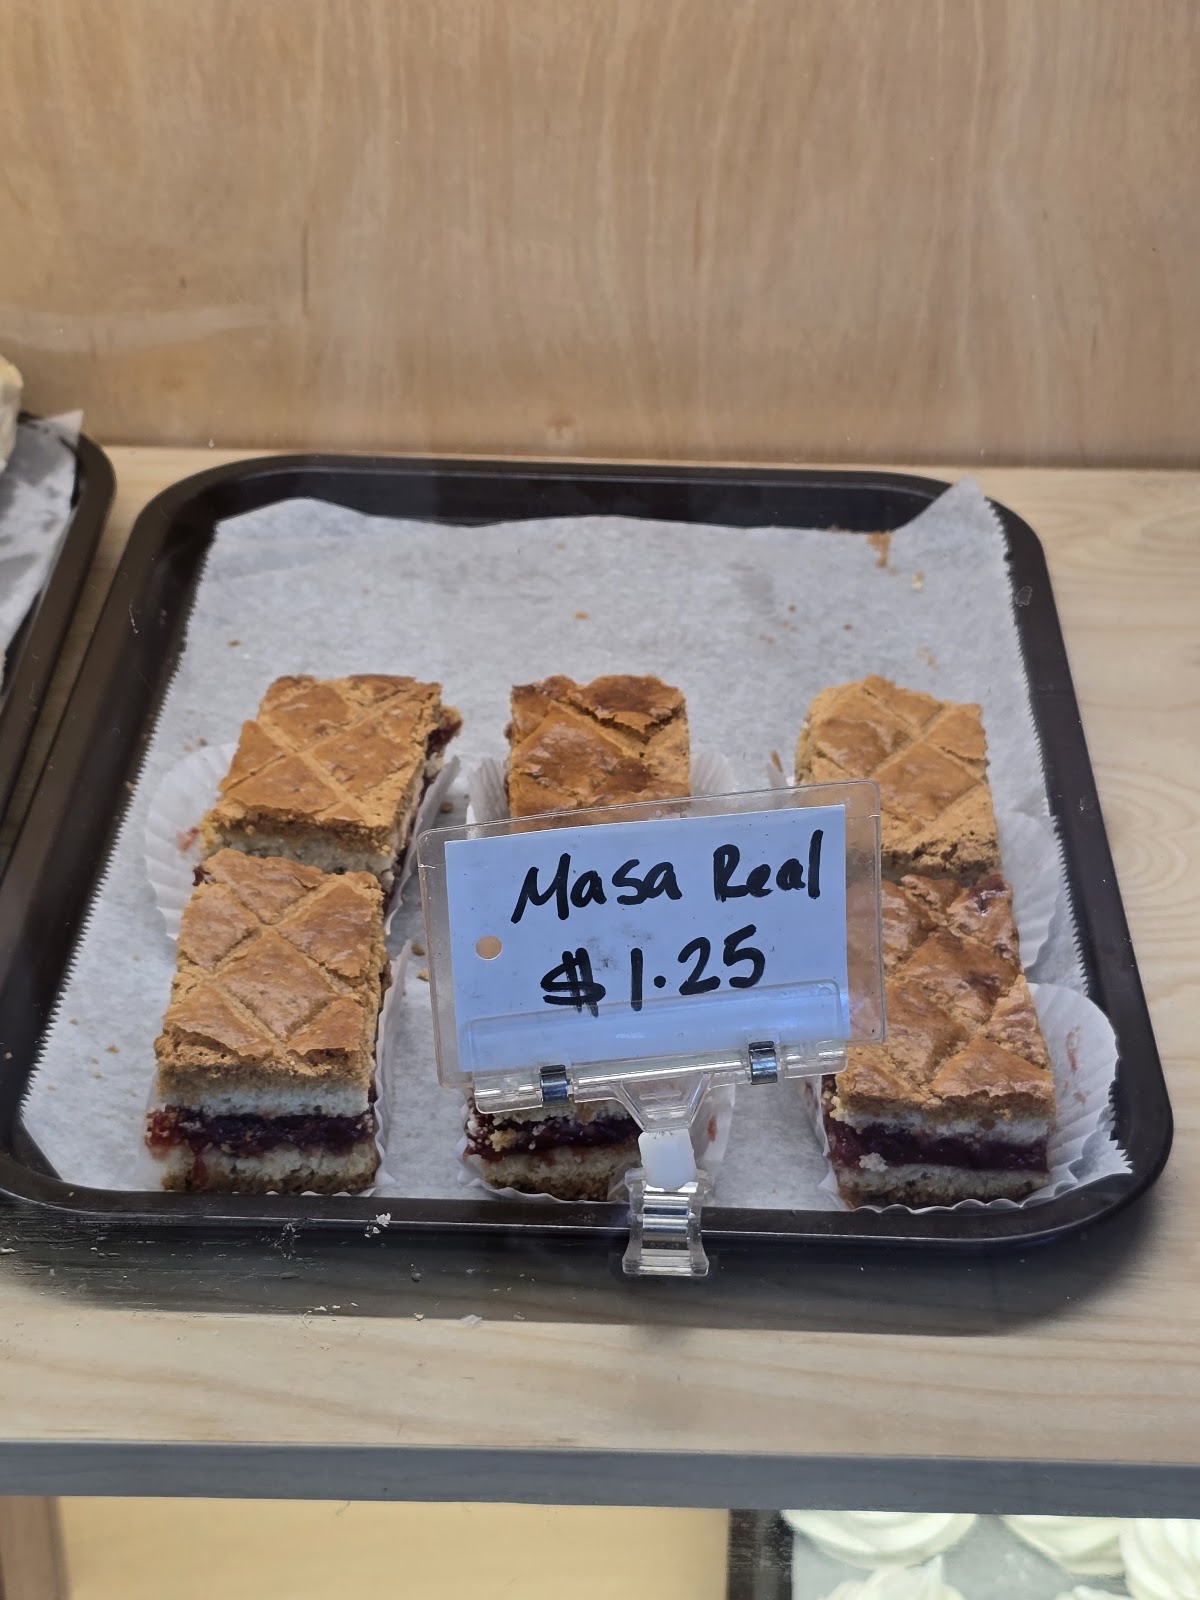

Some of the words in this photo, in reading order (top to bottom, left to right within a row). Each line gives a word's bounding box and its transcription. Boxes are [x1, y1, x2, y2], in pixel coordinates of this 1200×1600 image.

[510, 853, 683, 924] Masa
[712, 829, 824, 903] Real
[541, 924, 767, 1017] $1.25
